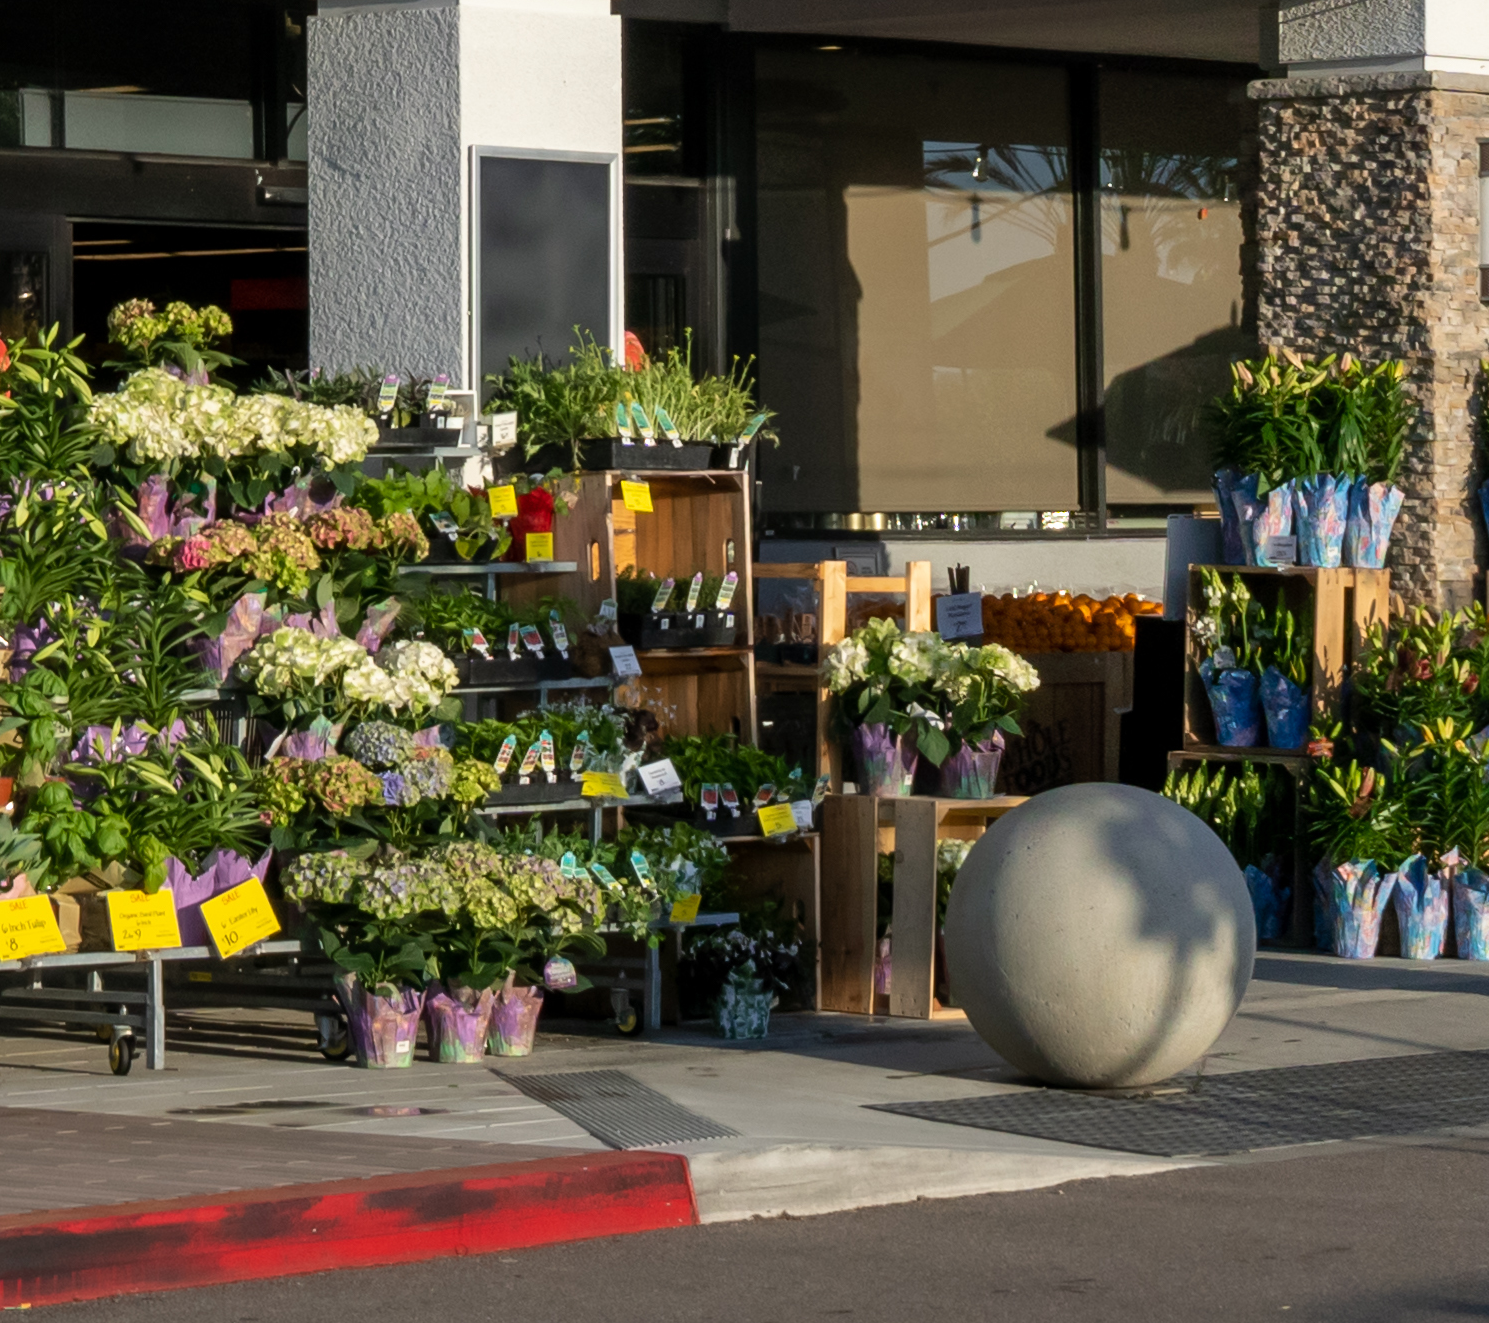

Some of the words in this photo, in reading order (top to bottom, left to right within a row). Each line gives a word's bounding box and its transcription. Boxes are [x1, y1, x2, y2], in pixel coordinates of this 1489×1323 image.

[130, 894, 151, 903] SALE
[221, 889, 241, 906] SALE
[9, 899, 28, 911] SALE
[1, 923, 8, 934] 6
